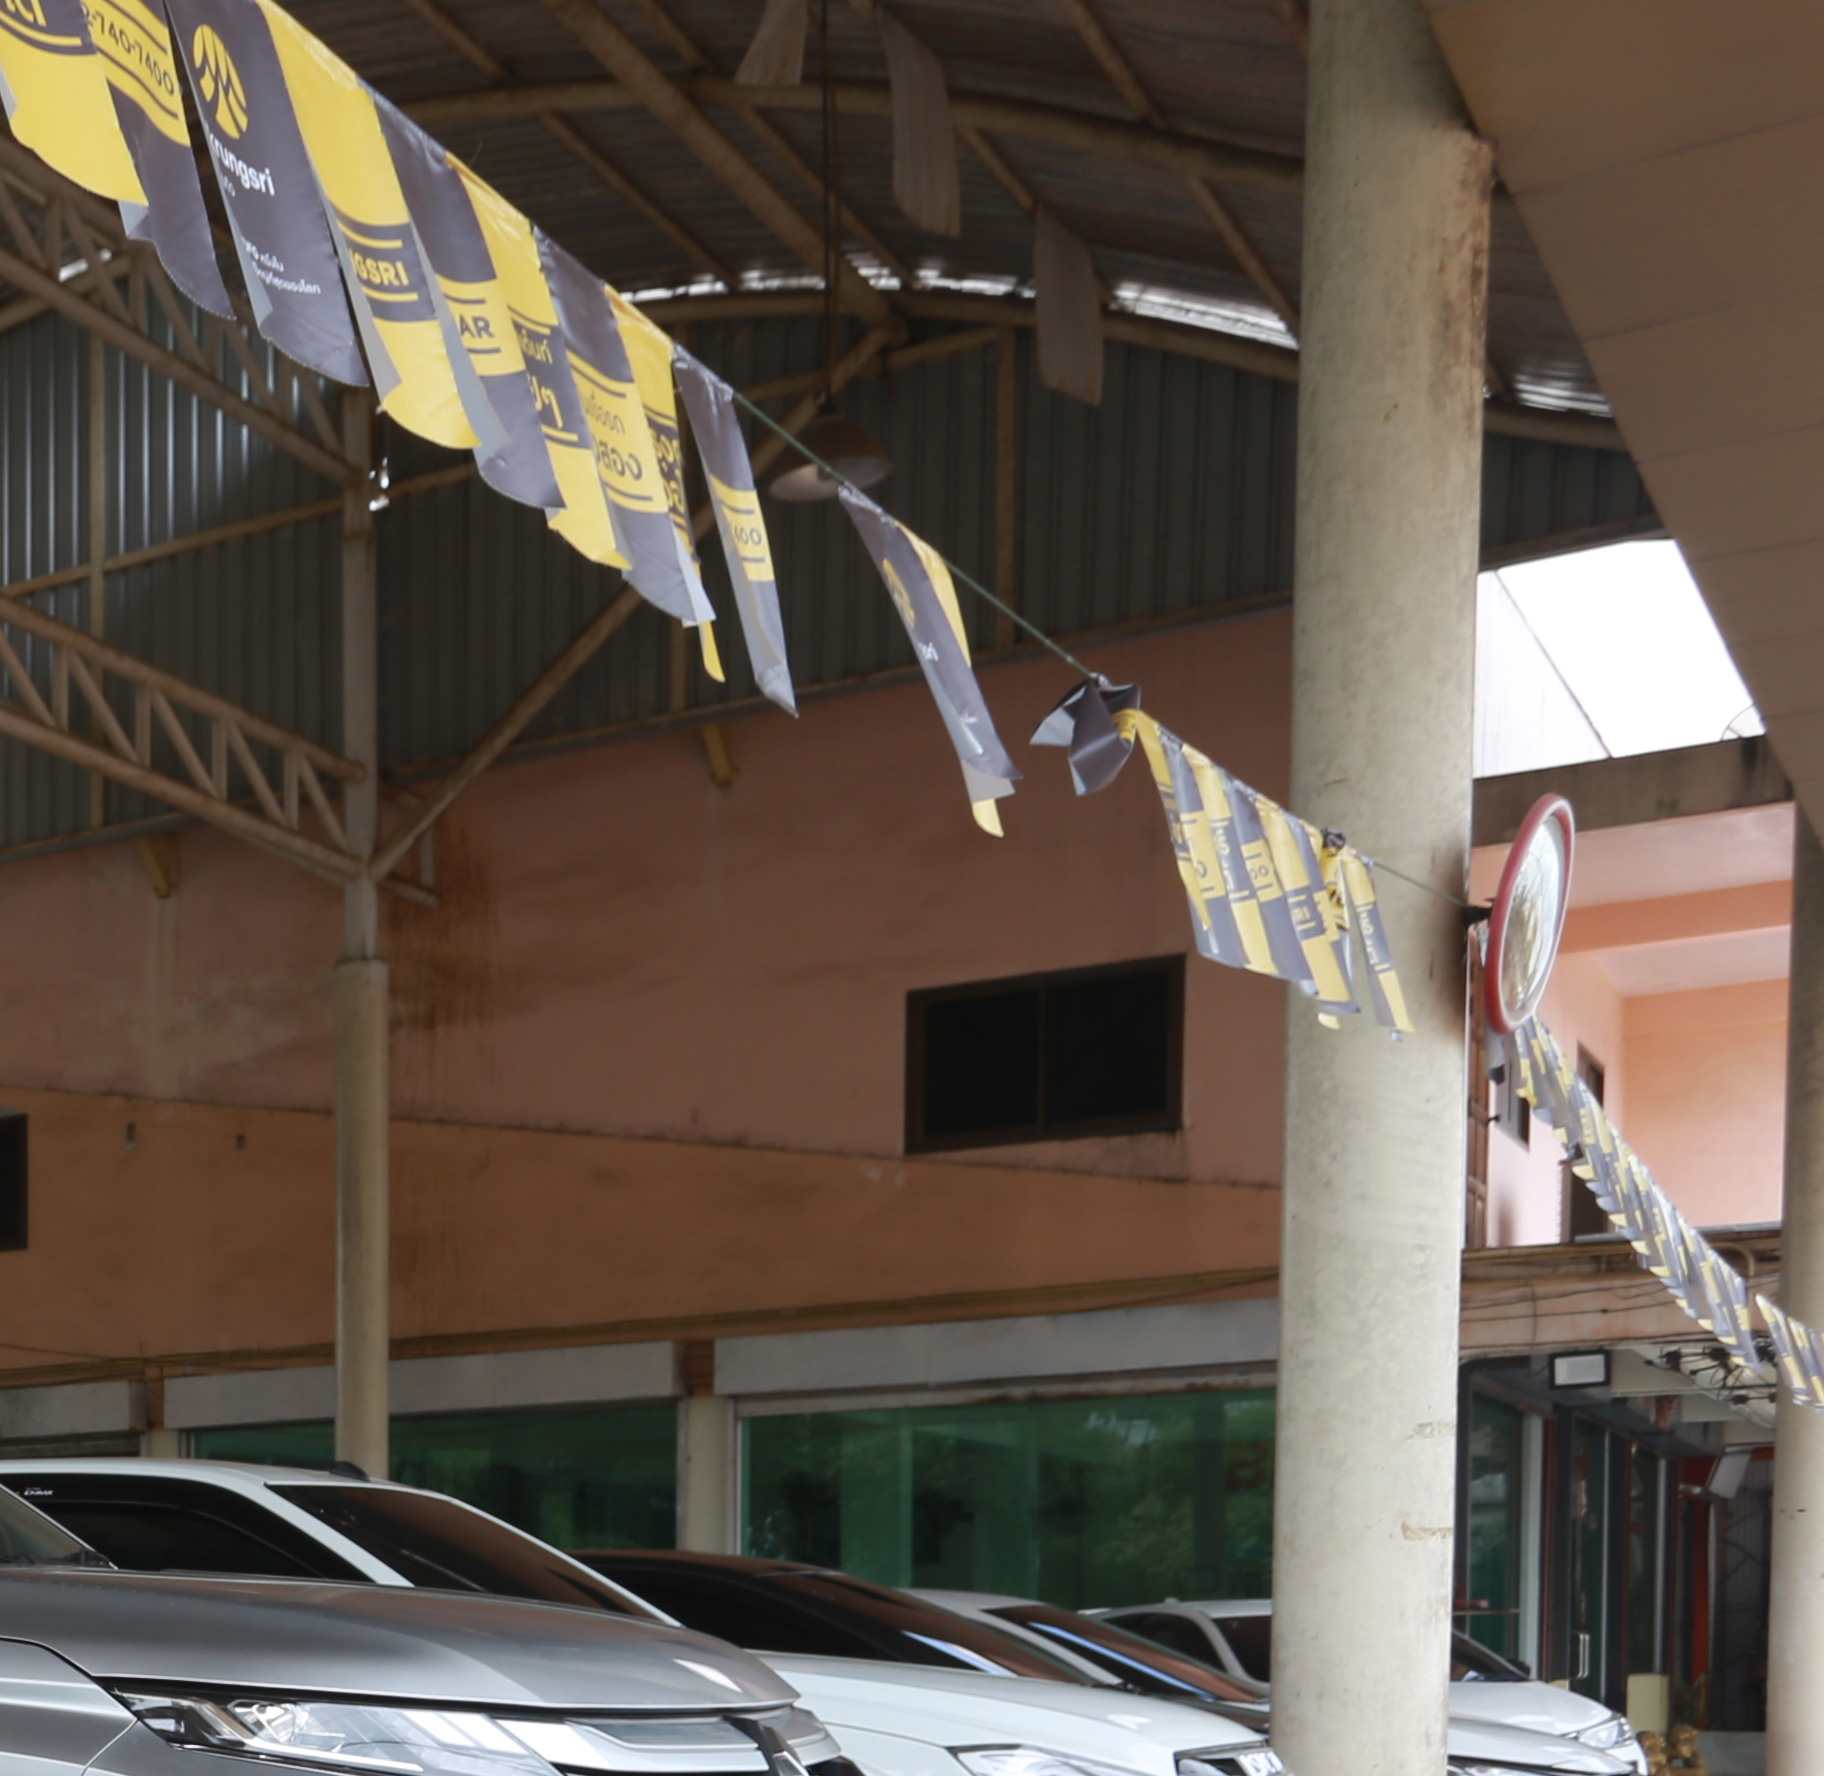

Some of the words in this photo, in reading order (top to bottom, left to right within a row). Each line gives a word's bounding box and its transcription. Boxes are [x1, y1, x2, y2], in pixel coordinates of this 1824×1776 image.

[82, 2, 176, 97] 2-740-7400
[351, 249, 410, 287] GSRI
[457, 312, 495, 340] AR
